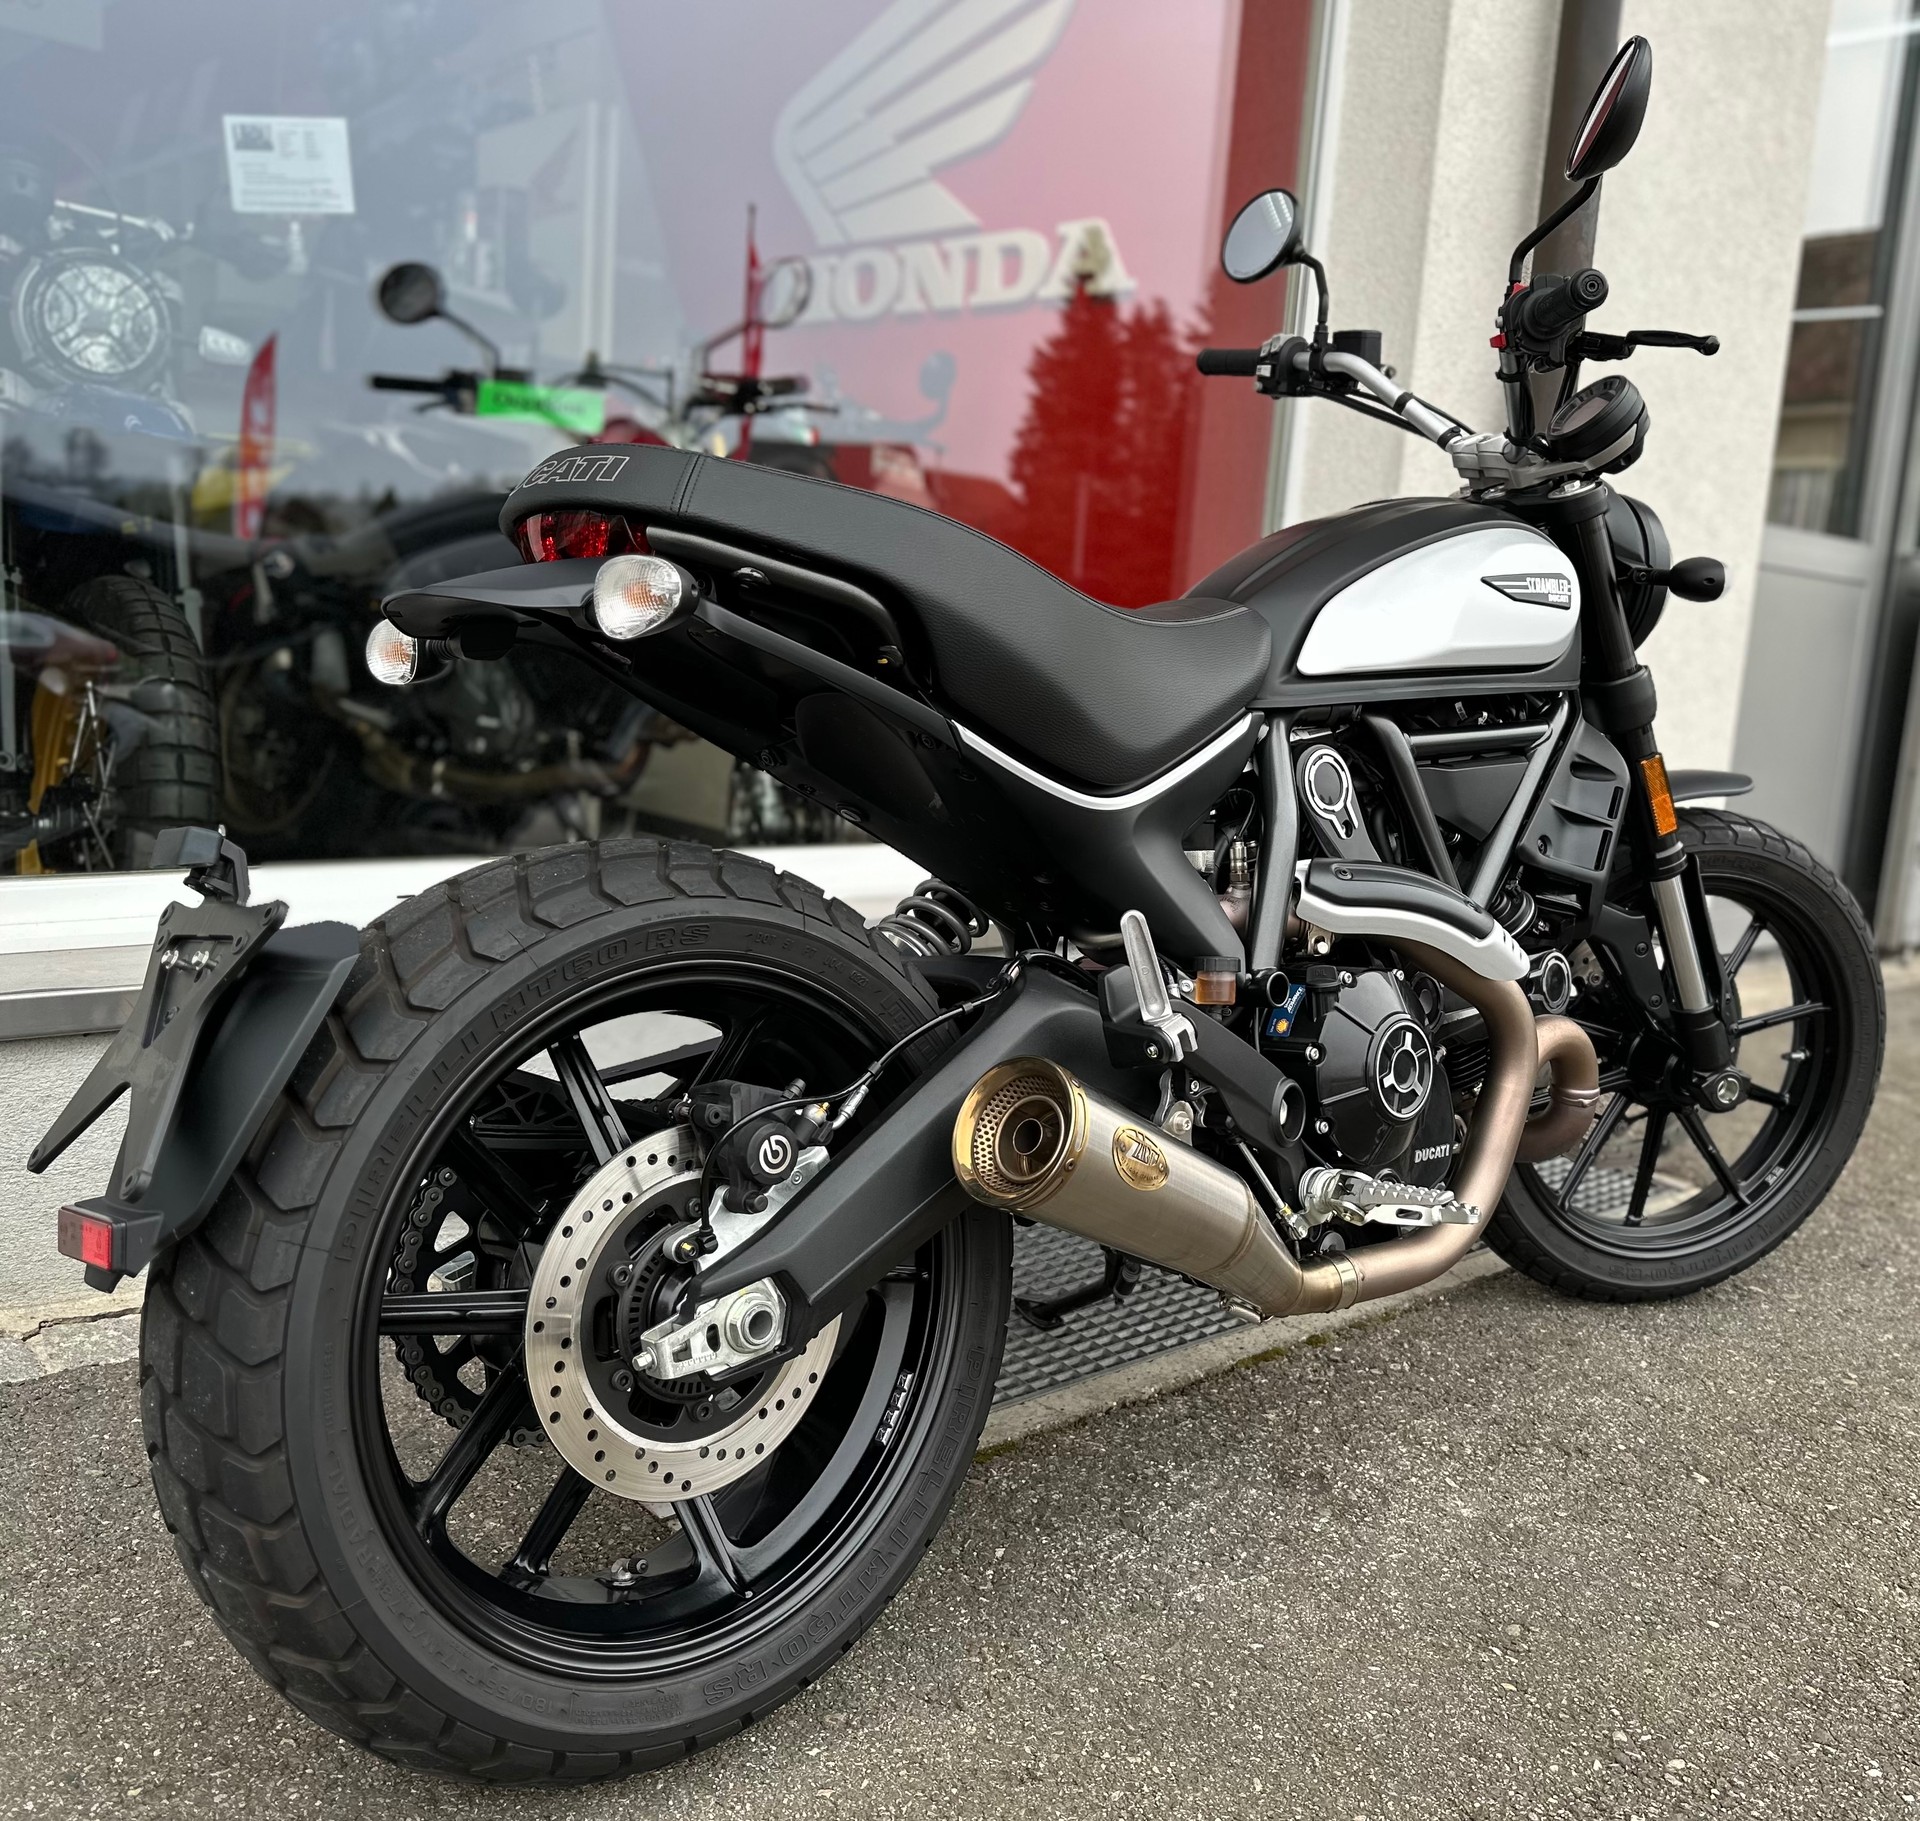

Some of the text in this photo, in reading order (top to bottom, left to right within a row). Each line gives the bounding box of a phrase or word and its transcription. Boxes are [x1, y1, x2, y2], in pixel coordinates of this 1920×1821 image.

[510, 455, 630, 496] CATI
[1526, 577, 1569, 595] SCRAMBLER
[334, 1030, 481, 1262] PIRELLI
[1414, 1143, 1450, 1163] DUCATI
[889, 1350, 985, 1550] PIRELLI
[329, 1457, 373, 1569] RADIAL
